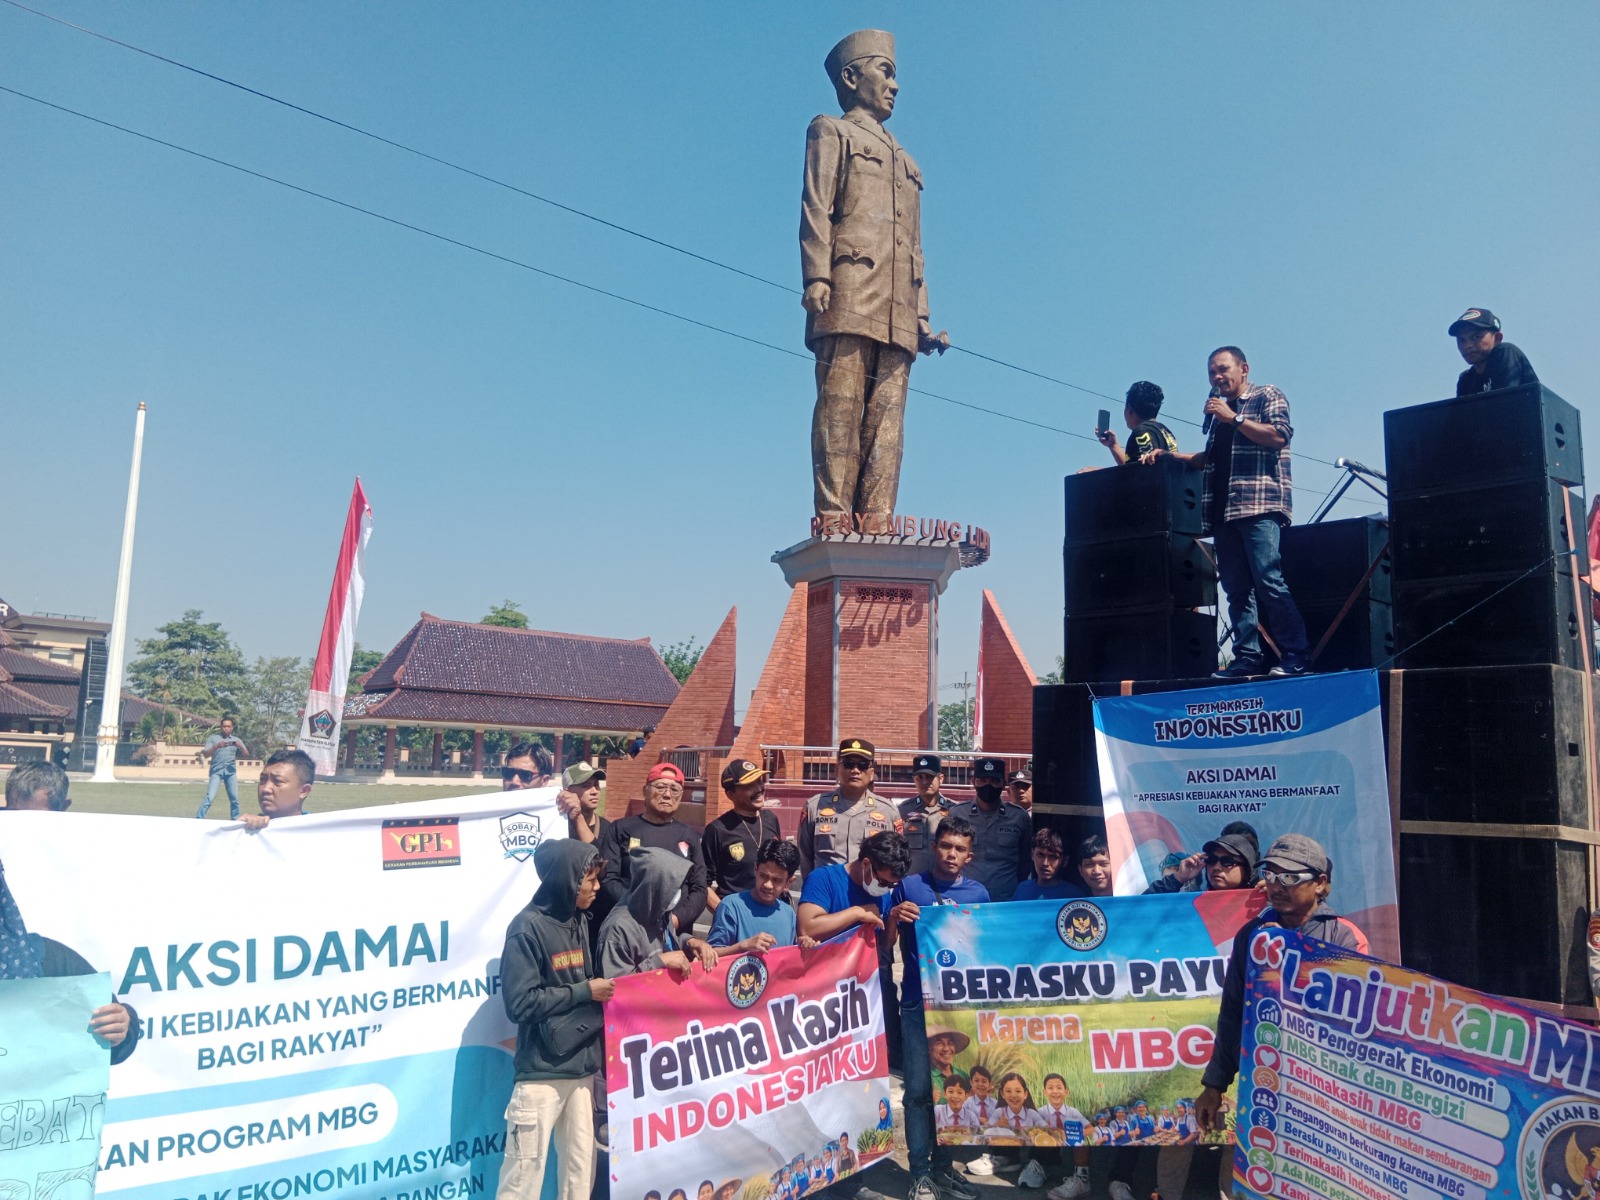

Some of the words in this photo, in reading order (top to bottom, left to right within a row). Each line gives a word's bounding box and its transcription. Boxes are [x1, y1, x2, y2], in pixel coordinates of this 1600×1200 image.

[810, 512, 962, 541] PENYAMBUNG
[1155, 709, 1302, 741] INDONESIAKU
[1186, 697, 1264, 716] TERIMAKASIH
[1185, 790, 1237, 801] KEBIJAKAN
[1238, 789, 1267, 799] YANG
[1269, 785, 1340, 798] BERMANFAAT
[1186, 769, 1220, 784] AKSI
[1223, 766, 1276, 782] DAMAI
[506, 823, 534, 833] SOBAT
[866, 820, 887, 830] POLRI
[1198, 804, 1222, 814] BAGI
[400, 832, 443, 854] GPI
[507, 834, 536, 847] MBG
[117, 938, 257, 995] AKSI
[273, 920, 450, 981] DAMAI
[941, 962, 1115, 1001] BERASKU
[161, 999, 310, 1039] KEBIJAKAN
[316, 990, 388, 1019] YANG
[393, 975, 502, 1009] BERMANF
[198, 1040, 264, 1070] BAGI
[624, 1022, 769, 1099] Terima
[770, 981, 870, 1055] Kasih
[978, 1011, 1081, 1042] Karena
[1092, 1028, 1216, 1070] MBG
[1286, 1012, 1315, 1039] MBG
[1318, 1025, 1407, 1072] Penggerak
[1410, 1056, 1494, 1103] Ekonomi
[632, 1038, 877, 1153] INDONESIAKU
[1287, 1035, 1318, 1063] MBG
[1320, 1051, 1360, 1082] Enak
[1363, 1068, 1397, 1096] dan
[1400, 1080, 1465, 1121] Bergizi
[1287, 1057, 1374, 1112] Terimakasih
[1377, 1099, 1422, 1131] MBG
[0, 1094, 103, 1150] EBAT
[157, 1113, 311, 1161] PROGRAM
[317, 1101, 379, 1134] MBG
[1286, 1081, 1313, 1102] Karena
[1313, 1093, 1330, 1111] MBG
[1331, 1105, 1368, 1133] anak-anak
[1369, 1122, 1392, 1142] tidak
[1393, 1134, 1424, 1155] makan
[1425, 1148, 1492, 1184] sembarangan
[1535, 1105, 1585, 1138] MAKAN
[1283, 1140, 1347, 1181] Terimakasih
[1284, 1121, 1324, 1149] Berasku
[1325, 1142, 1348, 1160] payu
[1348, 1152, 1381, 1180] karena
[1382, 1171, 1408, 1195] MBG
[1285, 1101, 1348, 1141] Pengangguran
[1349, 1132, 1397, 1169] berkurang
[1399, 1156, 1435, 1184] karena
[1437, 1173, 1465, 1197] MBG
[237, 1162, 367, 1200] EKONOMI
[1281, 1161, 1303, 1180] Ada
[1304, 1170, 1328, 1193] MBG
